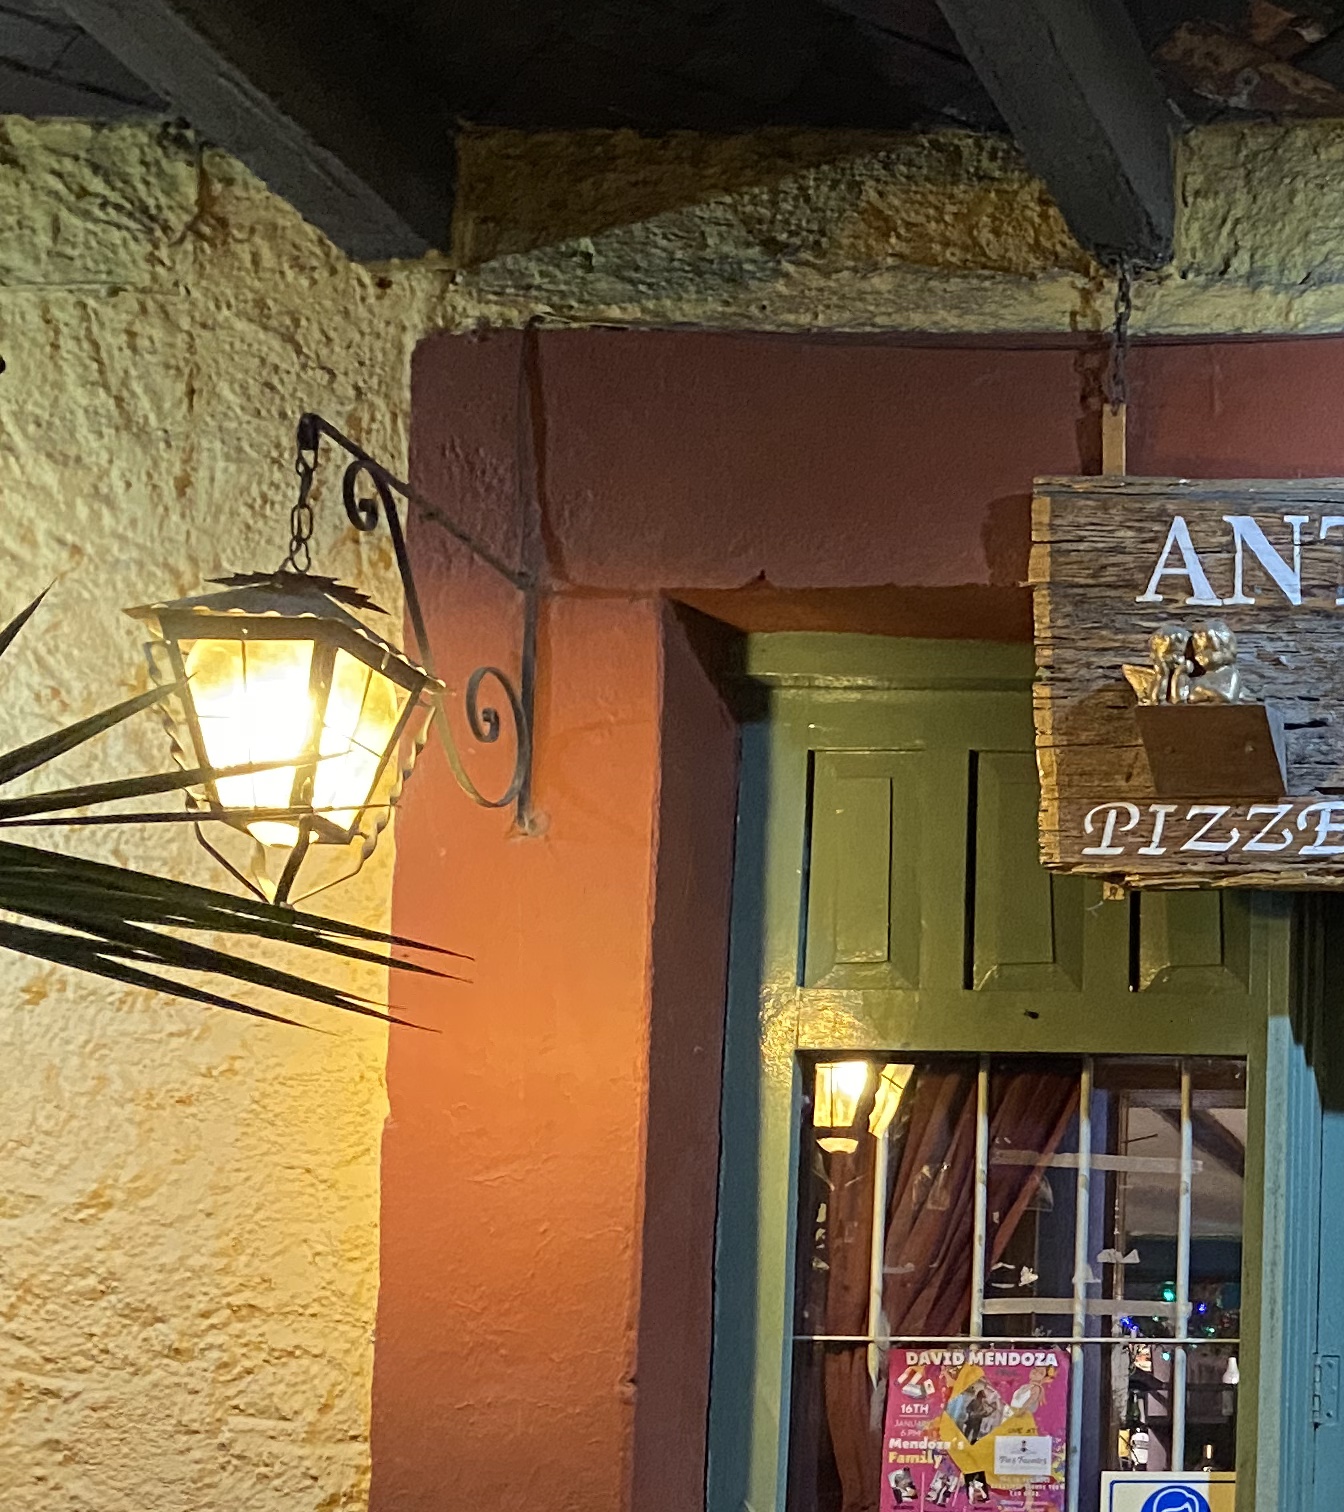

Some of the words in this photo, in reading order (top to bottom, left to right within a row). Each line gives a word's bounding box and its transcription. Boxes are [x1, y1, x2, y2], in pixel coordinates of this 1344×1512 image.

[906, 1352, 965, 1366] DAVID
[968, 1352, 1058, 1367] MENDOZA
[900, 1403, 929, 1414] 16TH
[889, 1451, 942, 1469] Family
